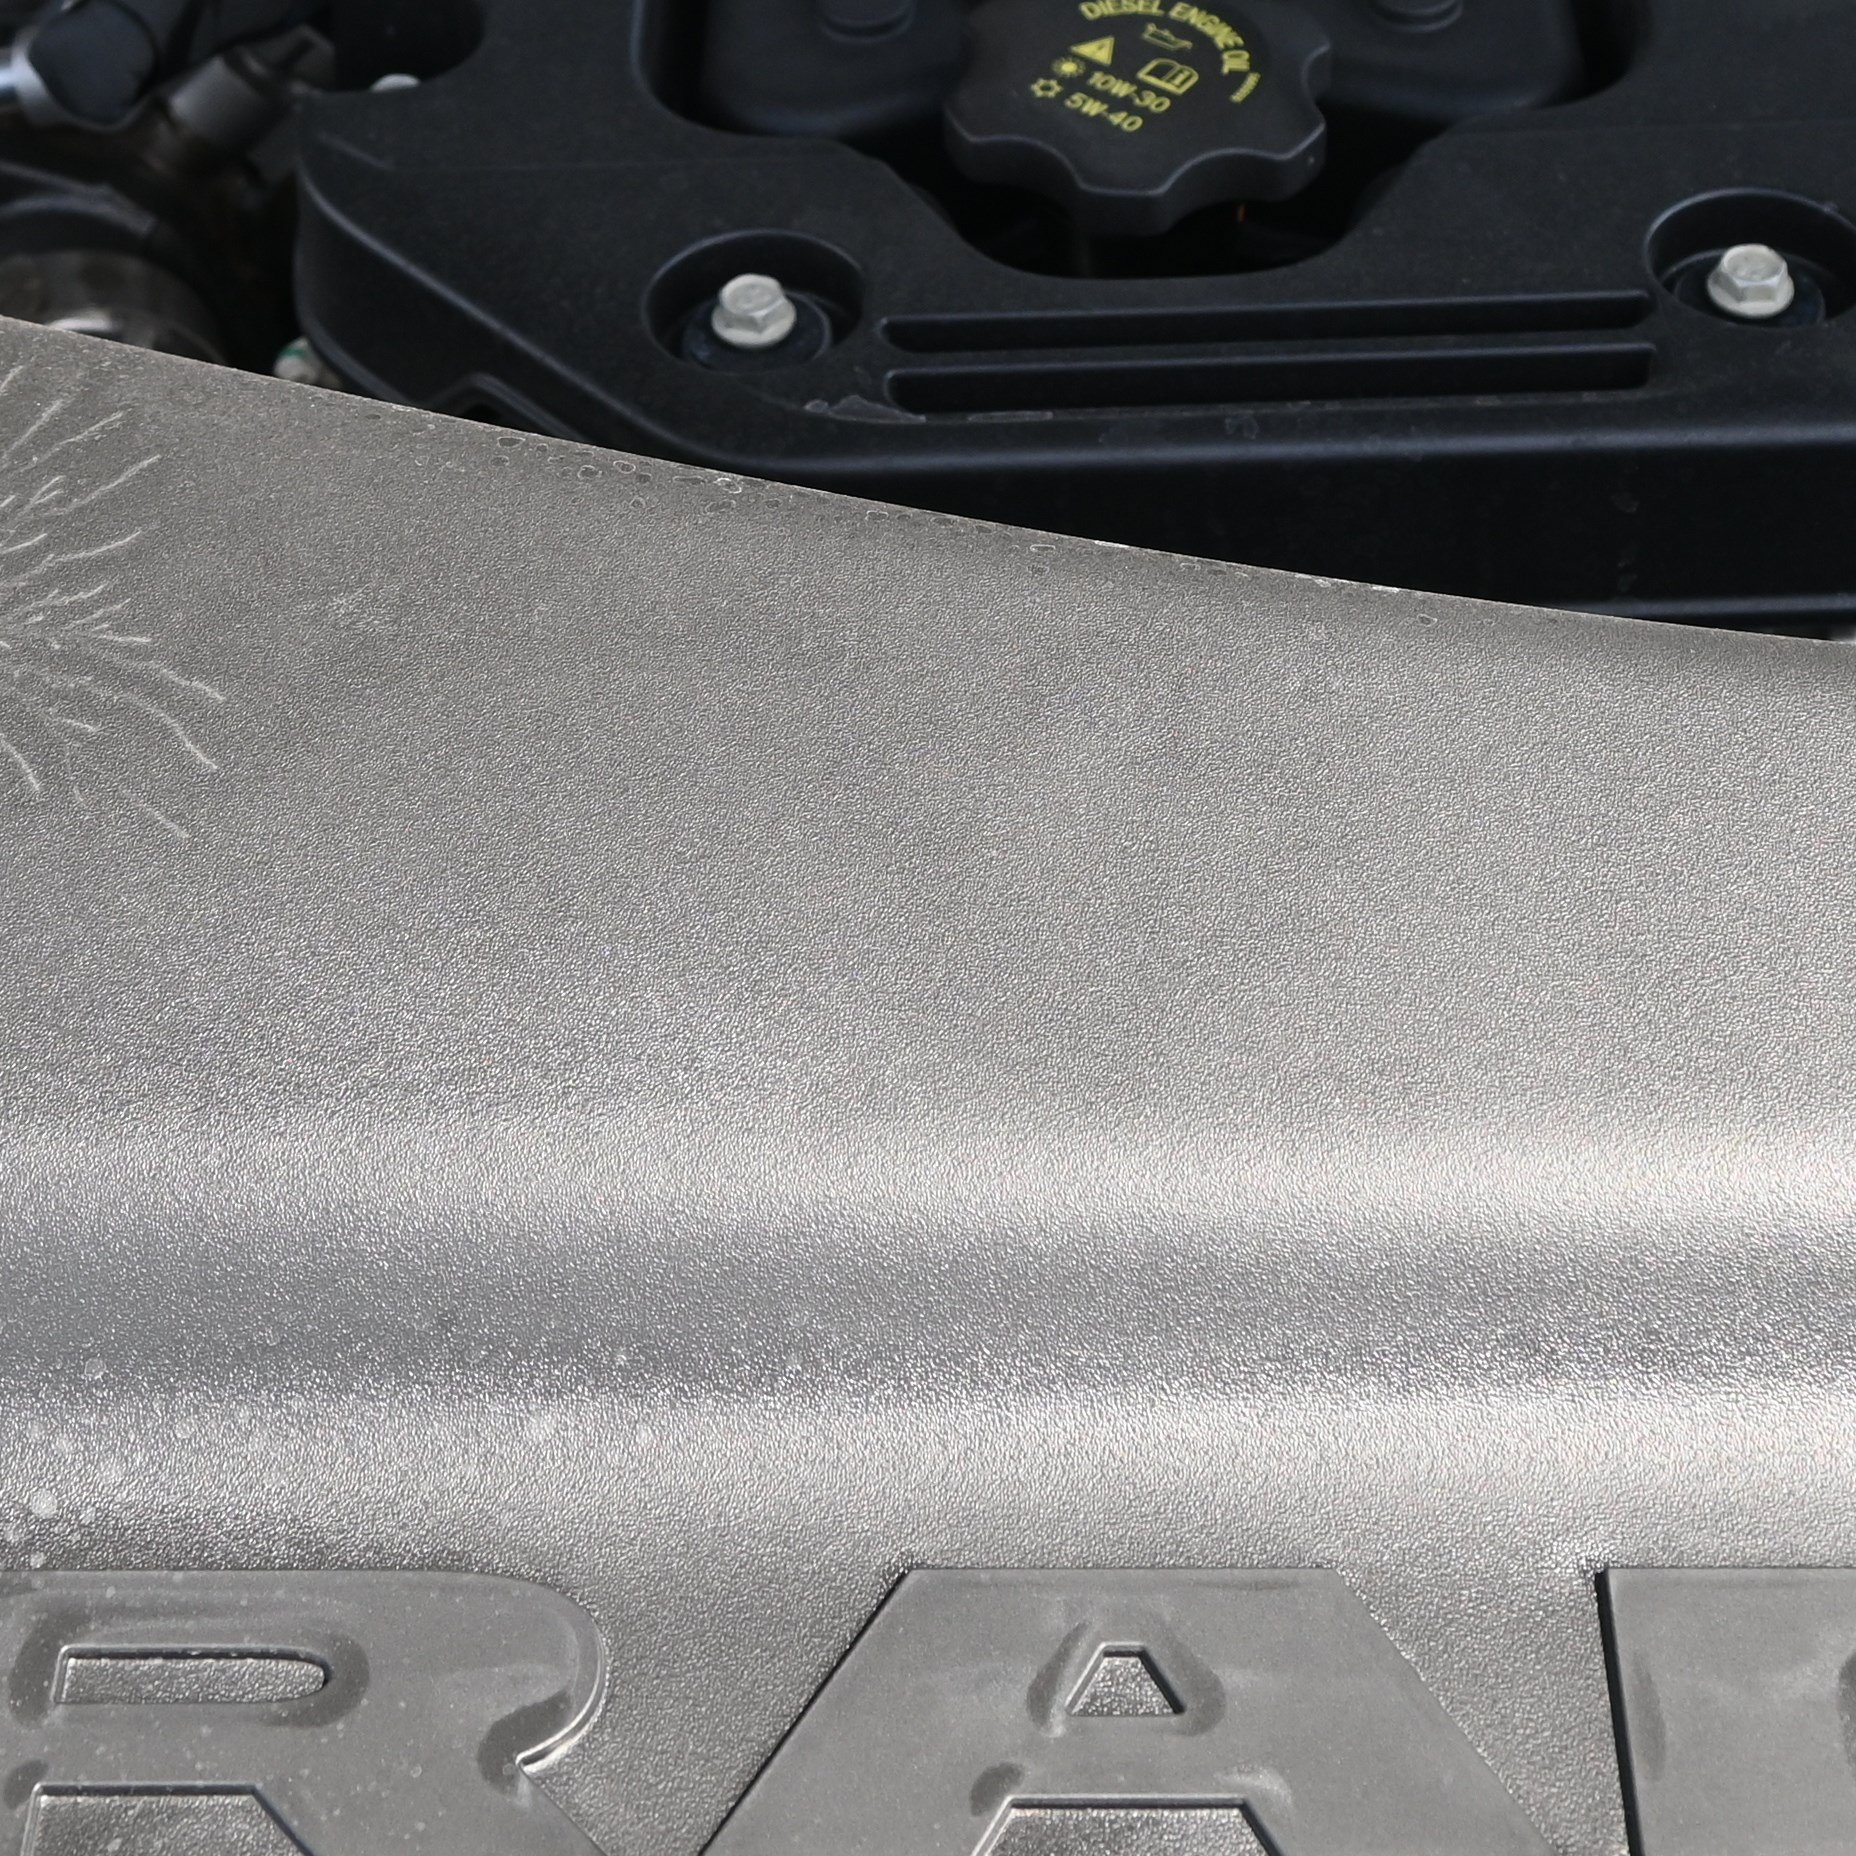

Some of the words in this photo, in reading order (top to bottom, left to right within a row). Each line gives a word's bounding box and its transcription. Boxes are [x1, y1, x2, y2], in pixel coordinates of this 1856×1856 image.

[1168, 1, 1245, 50] ENGINE
[1220, 49, 1251, 75] OIL
[1064, 92, 1144, 133] 5W-40
[1086, 71, 1172, 113] 10W-30
